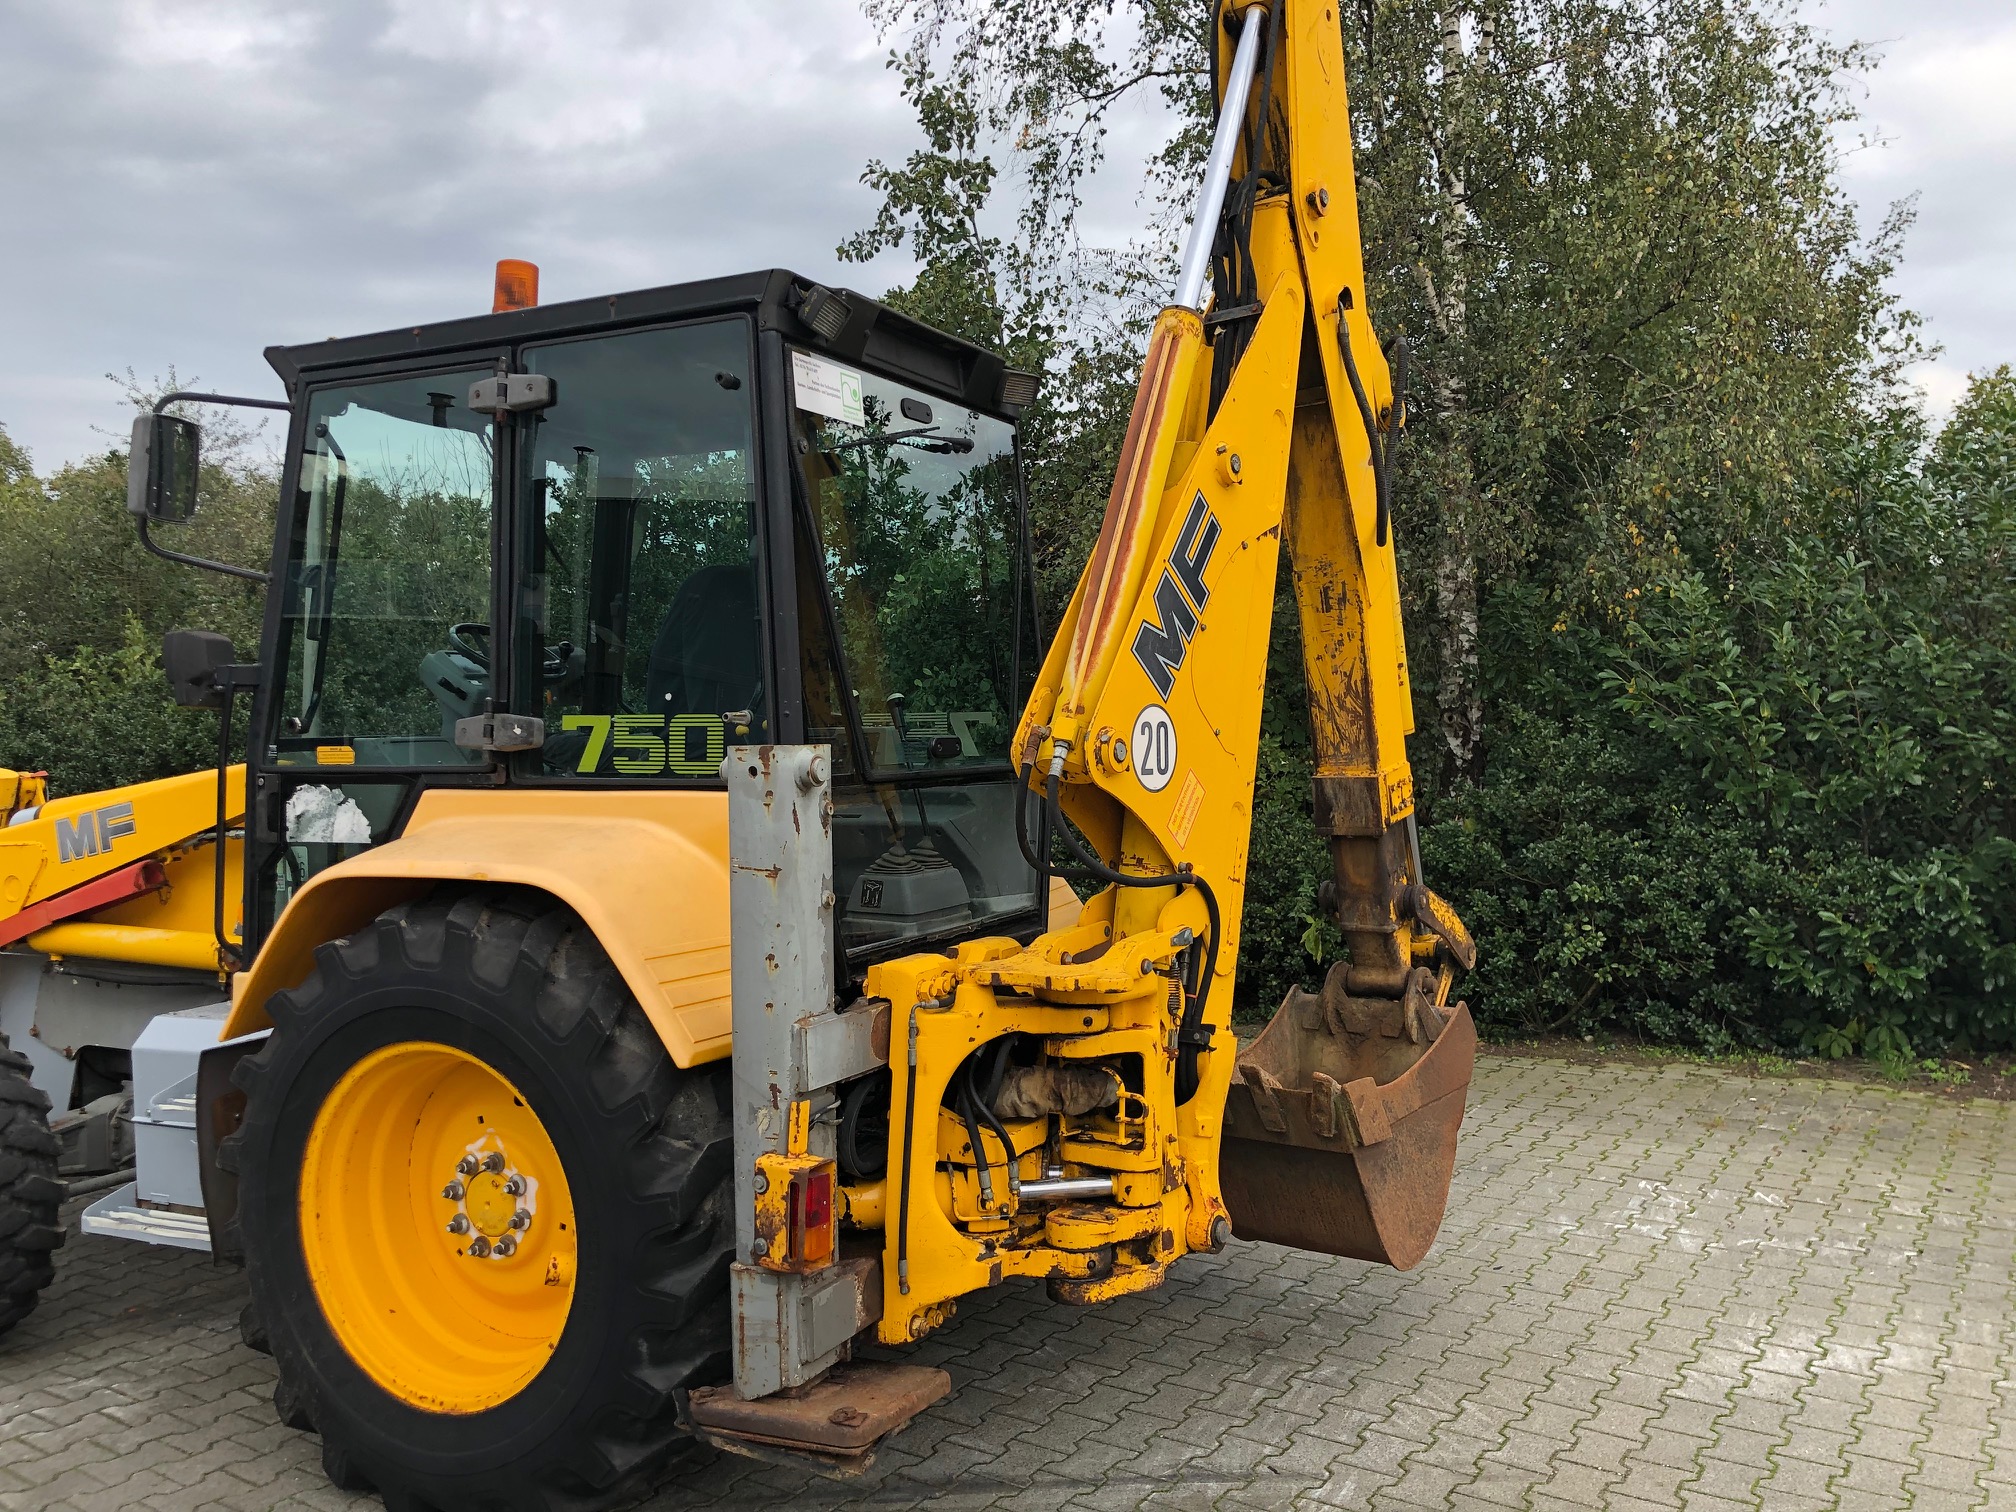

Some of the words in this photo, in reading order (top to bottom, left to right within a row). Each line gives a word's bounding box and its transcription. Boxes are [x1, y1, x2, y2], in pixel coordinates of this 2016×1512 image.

[1131, 489, 1222, 703] MF
[562, 714, 724, 775] 750
[1141, 721, 1169, 775] 20
[55, 801, 136, 864] MF
